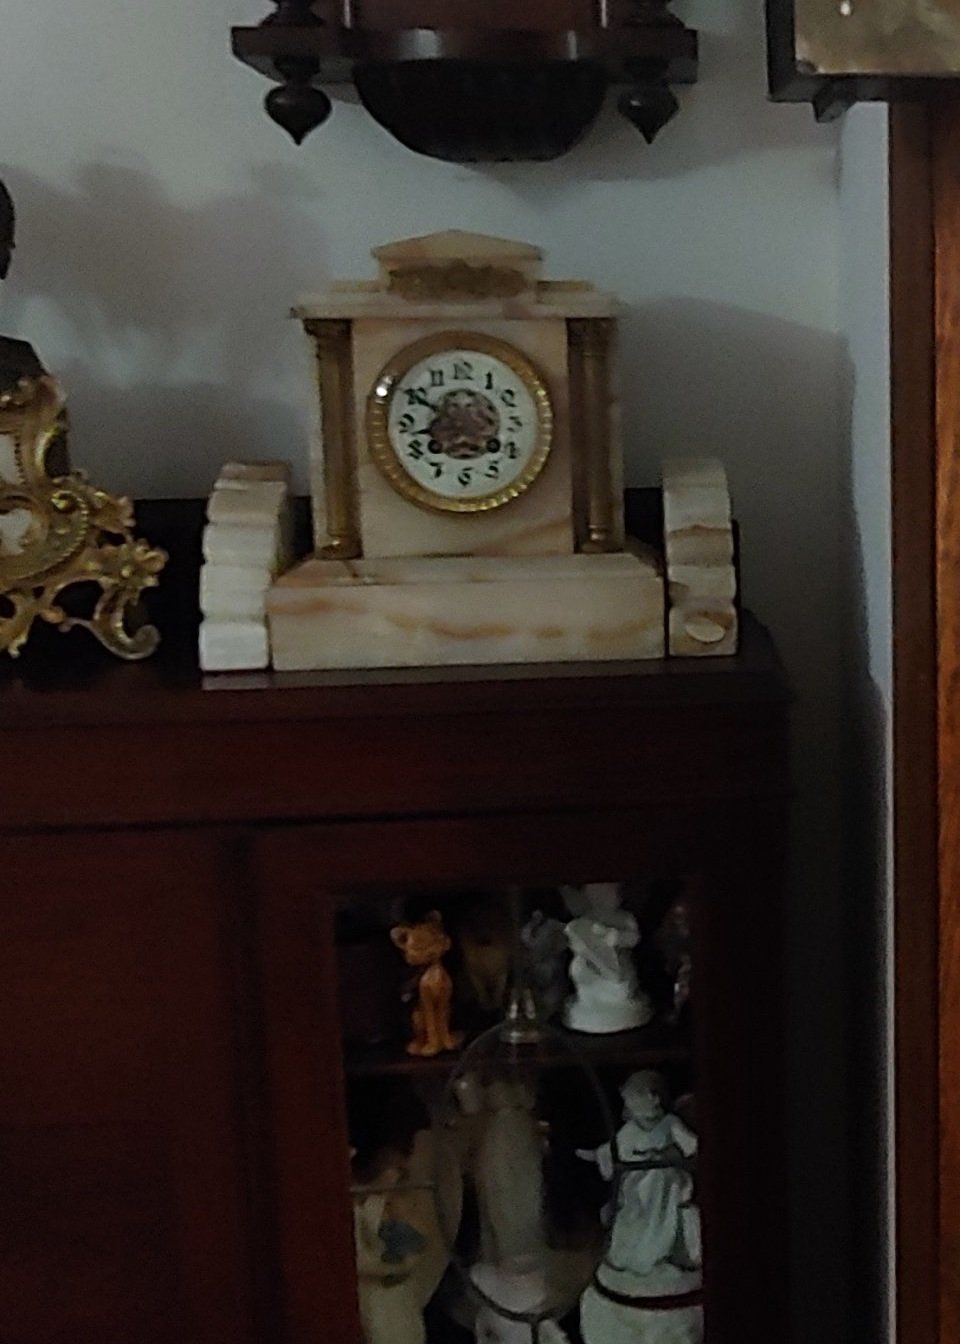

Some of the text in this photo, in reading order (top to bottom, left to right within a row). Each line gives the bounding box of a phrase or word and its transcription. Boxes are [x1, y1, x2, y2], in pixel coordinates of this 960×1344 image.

[430, 368, 445, 387] 11
[453, 361, 474, 381] 12
[485, 372, 493, 390] 1
[501, 389, 517, 407] 2
[398, 412, 415, 434] 9
[408, 439, 425, 460] 8
[457, 467, 475, 487] 6
[484, 460, 500, 480] 5
